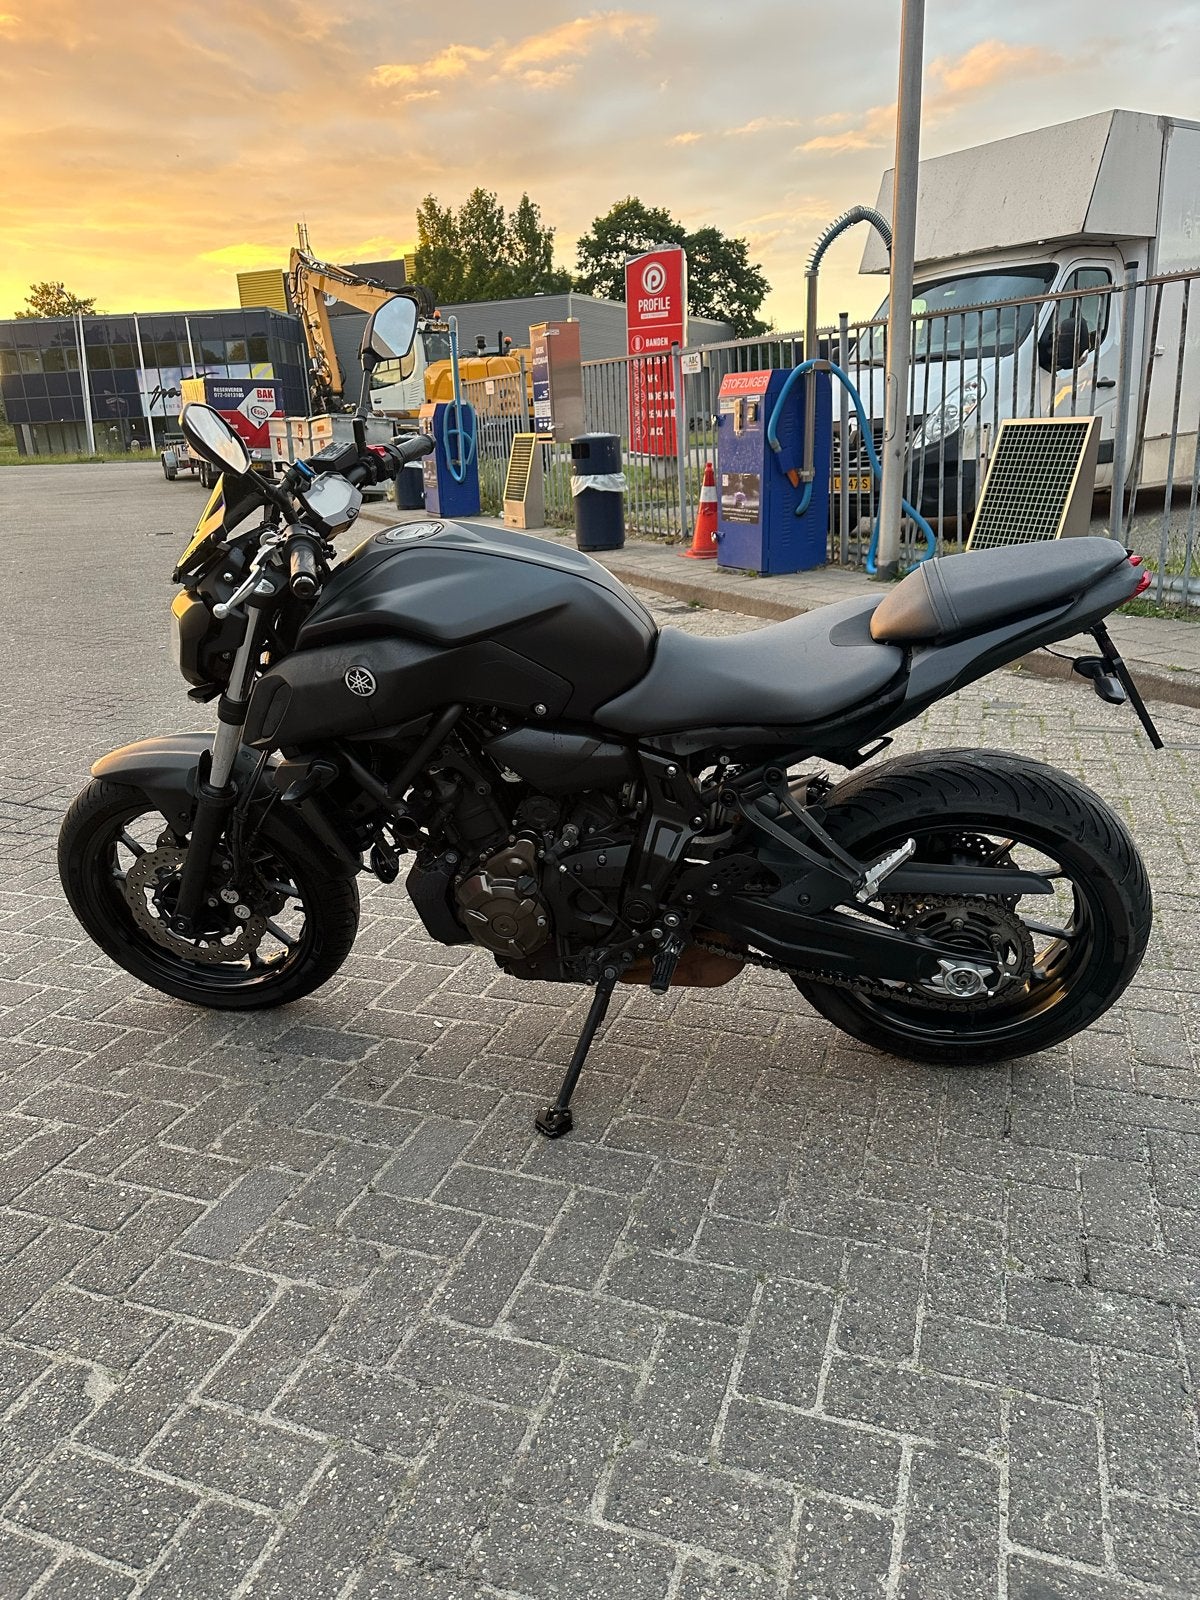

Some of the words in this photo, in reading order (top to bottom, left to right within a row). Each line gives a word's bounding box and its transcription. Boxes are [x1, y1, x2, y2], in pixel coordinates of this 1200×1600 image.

[638, 296, 671, 312] PROFILE
[645, 337, 669, 347] BANDEN
[722, 376, 769, 390] STOFZUIGER
[256, 389, 274, 399] BAK
